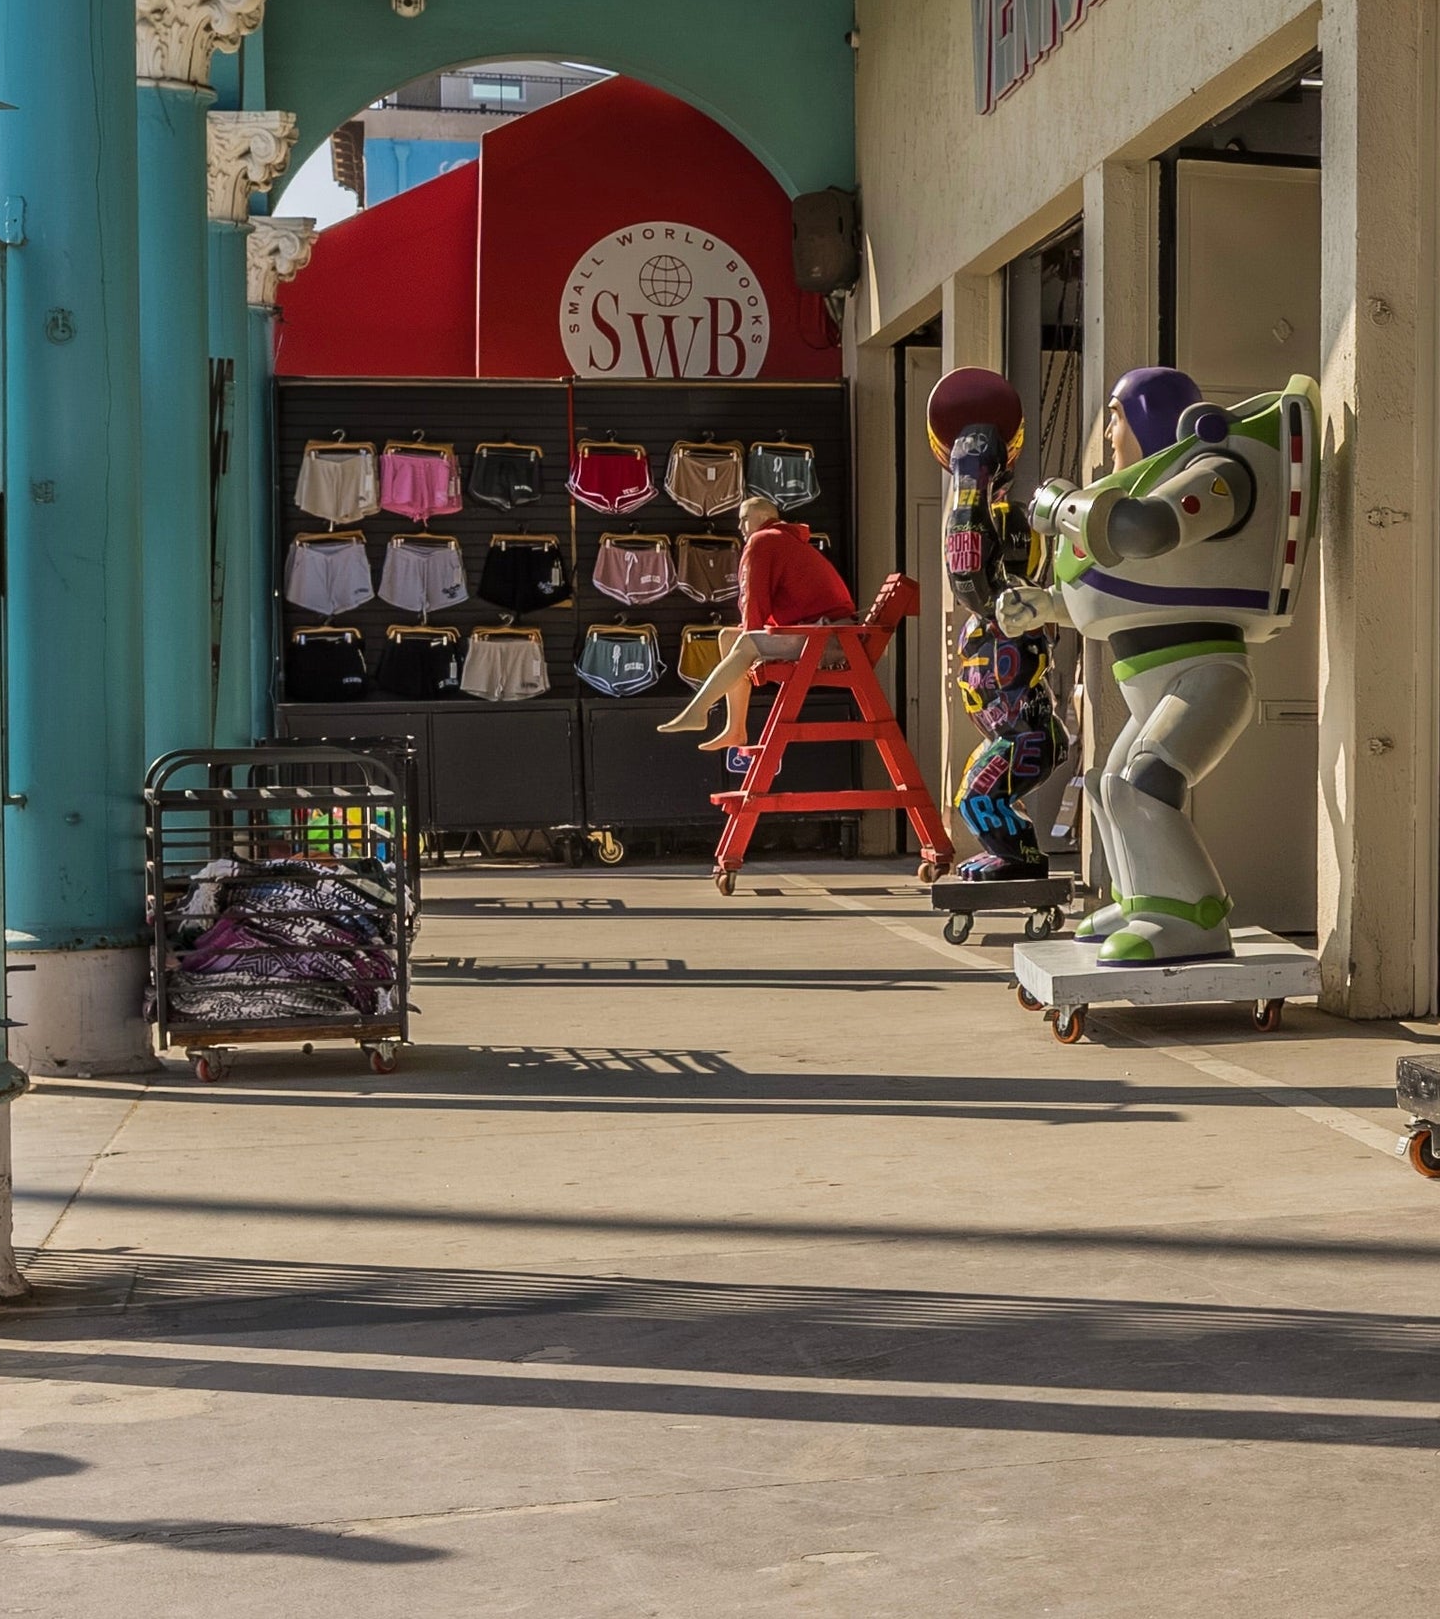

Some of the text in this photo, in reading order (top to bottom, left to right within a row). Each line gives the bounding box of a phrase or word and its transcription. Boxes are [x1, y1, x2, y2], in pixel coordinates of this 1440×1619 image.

[567, 227, 764, 346] SMALL WORLD BOOKS
[588, 289, 748, 379] SWB
[948, 531, 981, 553] BORN
[950, 551, 981, 573] WILD
